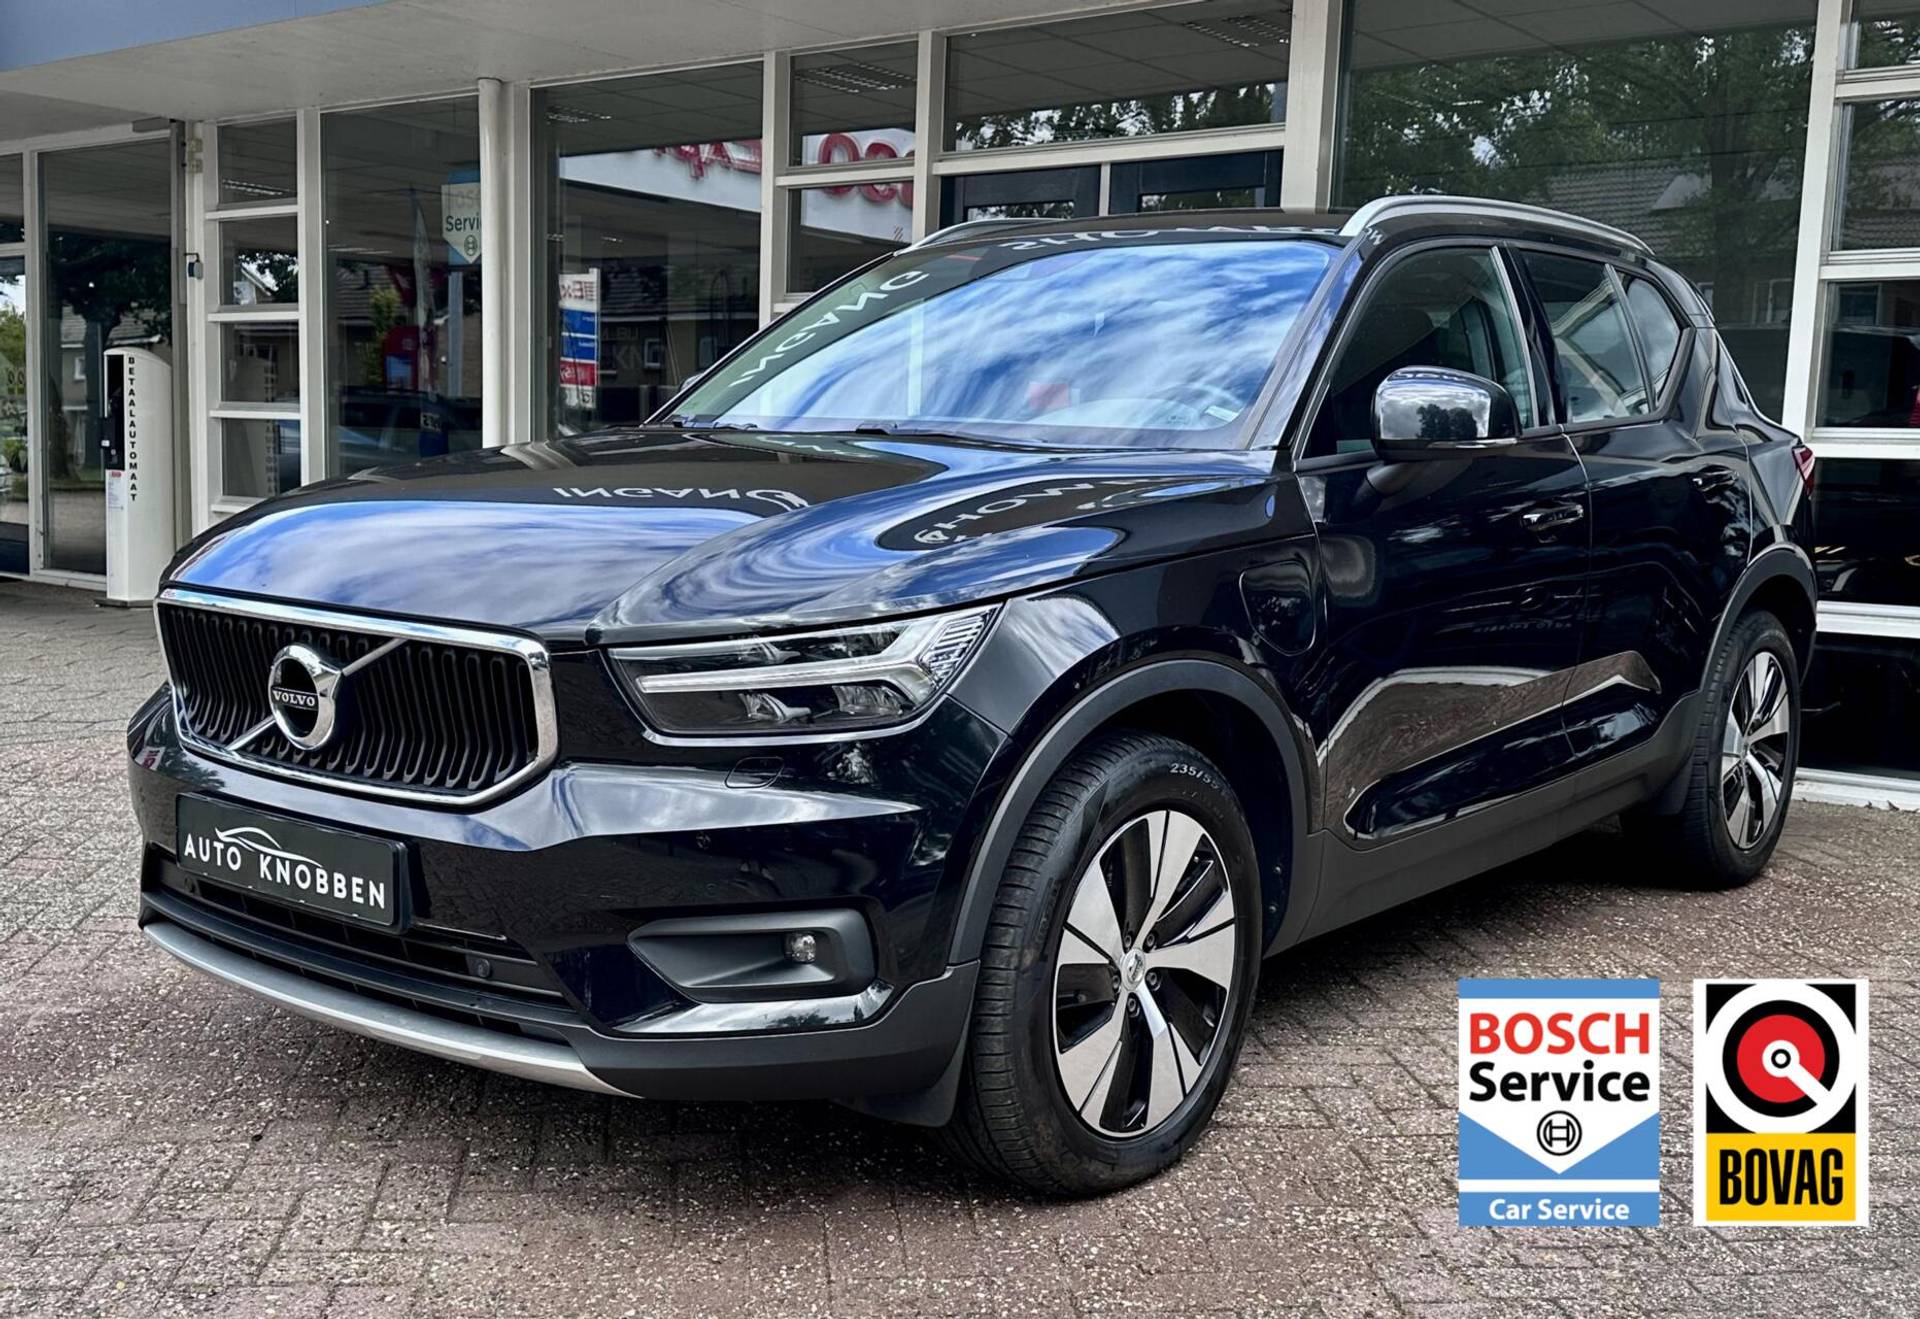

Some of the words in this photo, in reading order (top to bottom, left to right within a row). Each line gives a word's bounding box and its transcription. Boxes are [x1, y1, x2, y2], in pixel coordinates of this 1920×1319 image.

[445, 211, 481, 232] Servi
[127, 357, 138, 501] BETAALAUTOMAAT
[272, 690, 315, 706] VOLVO
[184, 833, 242, 871] AUTO
[260, 853, 385, 909] KNOBBEN
